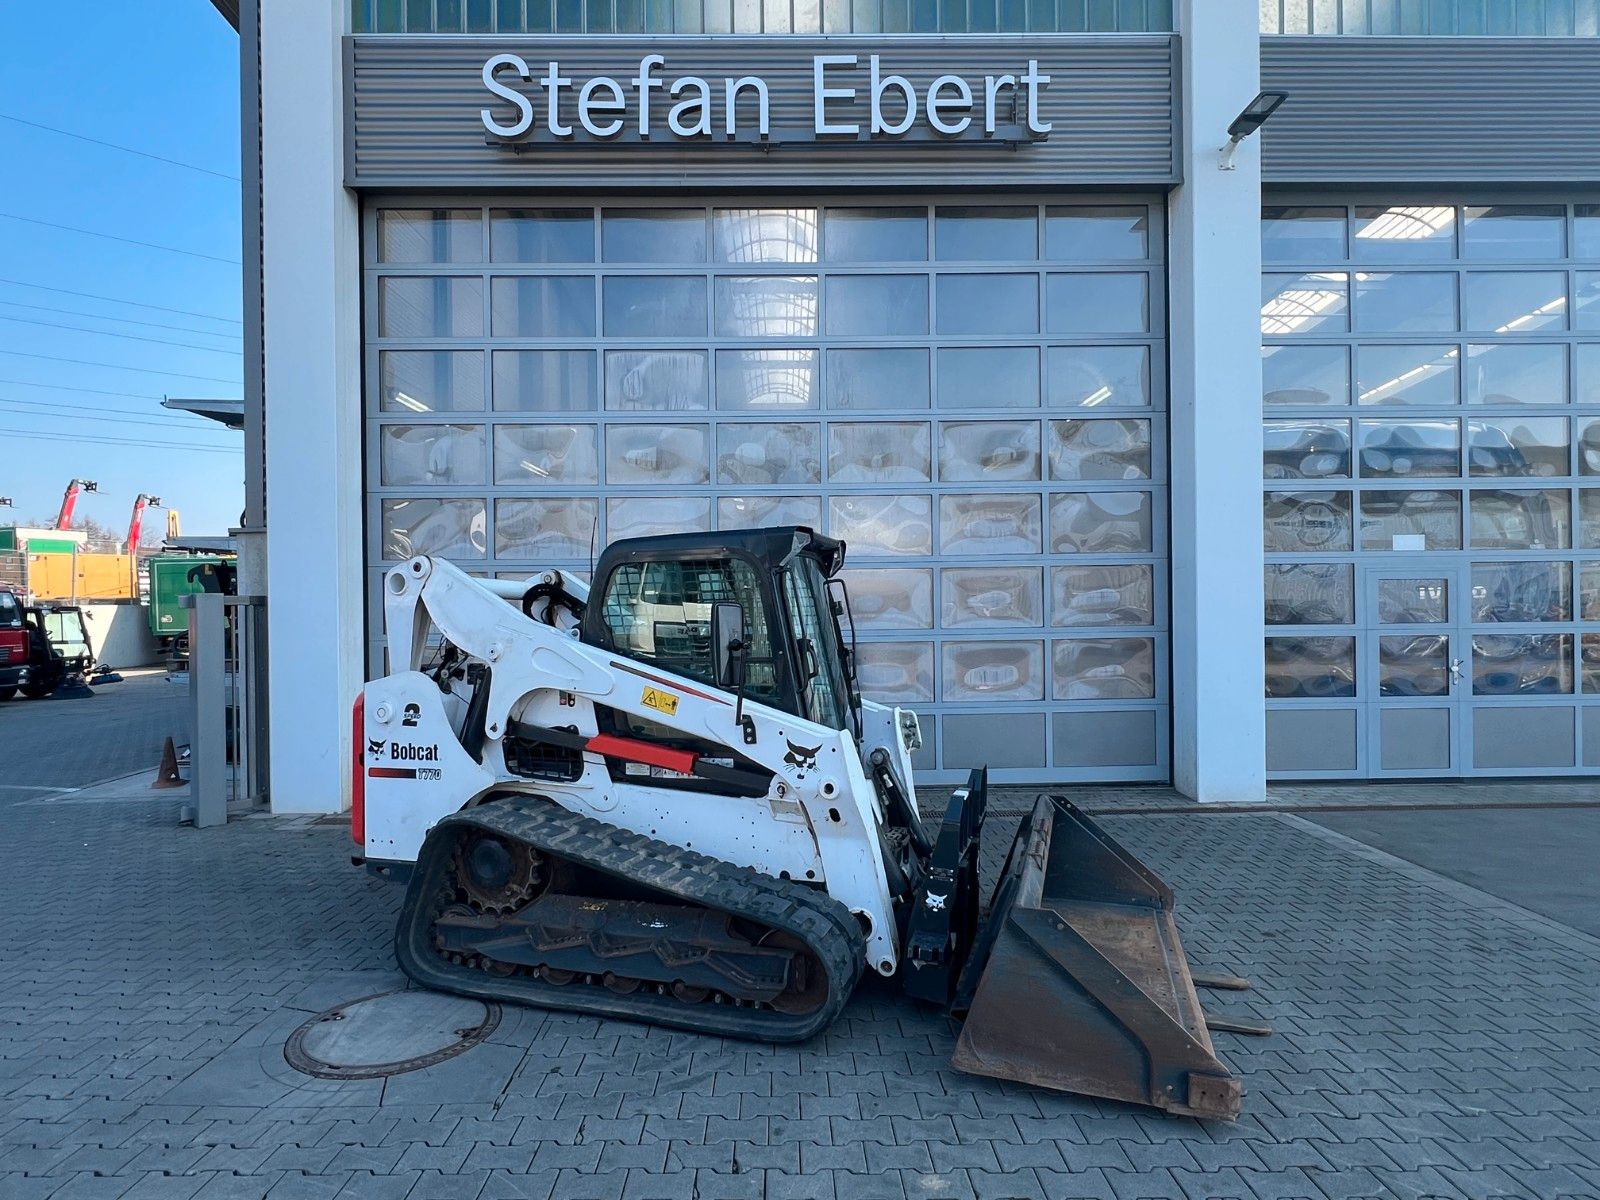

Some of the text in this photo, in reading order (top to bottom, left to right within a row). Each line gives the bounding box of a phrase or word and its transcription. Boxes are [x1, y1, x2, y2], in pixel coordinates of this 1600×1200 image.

[480, 53, 1052, 138] Stefan Ebert
[402, 703, 420, 727] 2
[391, 743, 438, 761] Bobcat
[417, 768, 442, 780] T770
